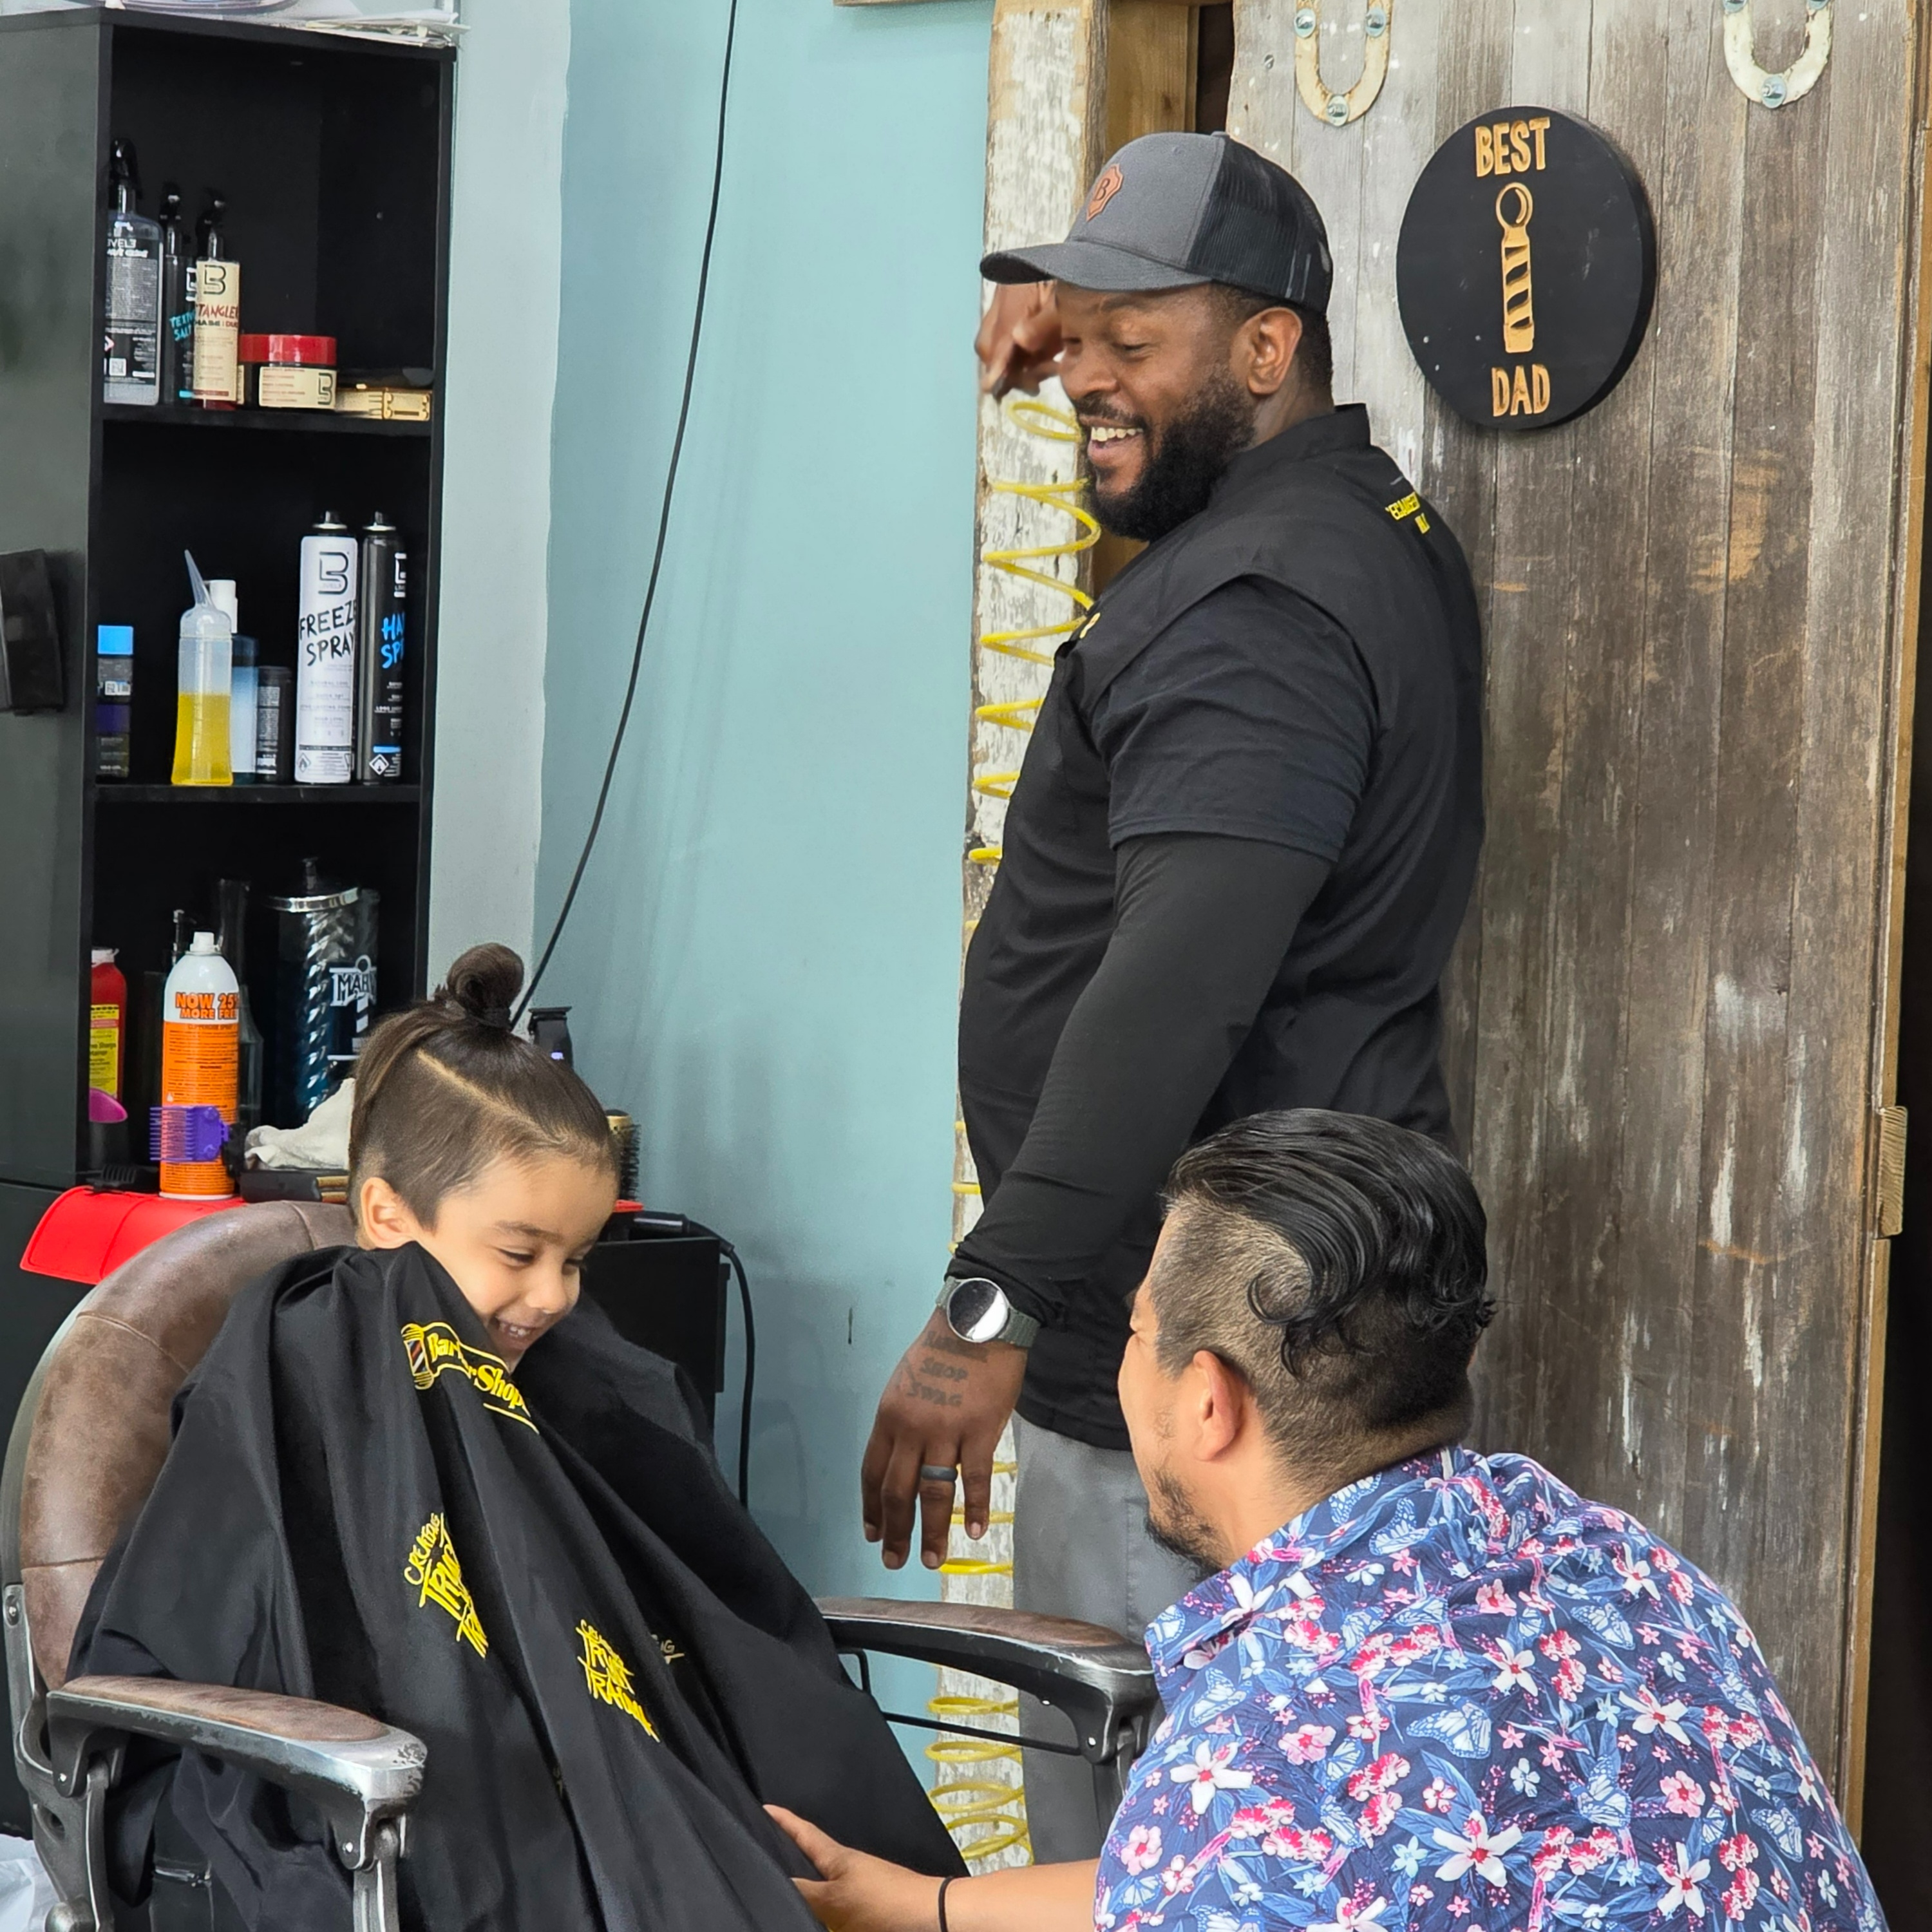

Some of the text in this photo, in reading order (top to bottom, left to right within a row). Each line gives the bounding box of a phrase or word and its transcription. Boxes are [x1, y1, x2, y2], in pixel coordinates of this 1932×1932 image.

[1475, 117, 1550, 177] BEST
[1092, 177, 1111, 202] B
[196, 303, 239, 319] TANGLE
[1492, 364, 1550, 417] DAD
[175, 992, 241, 1010] NOW 25
[334, 972, 377, 1003] MAR
[180, 1007, 216, 1020] MORE
[474, 1364, 525, 1409] Shop
